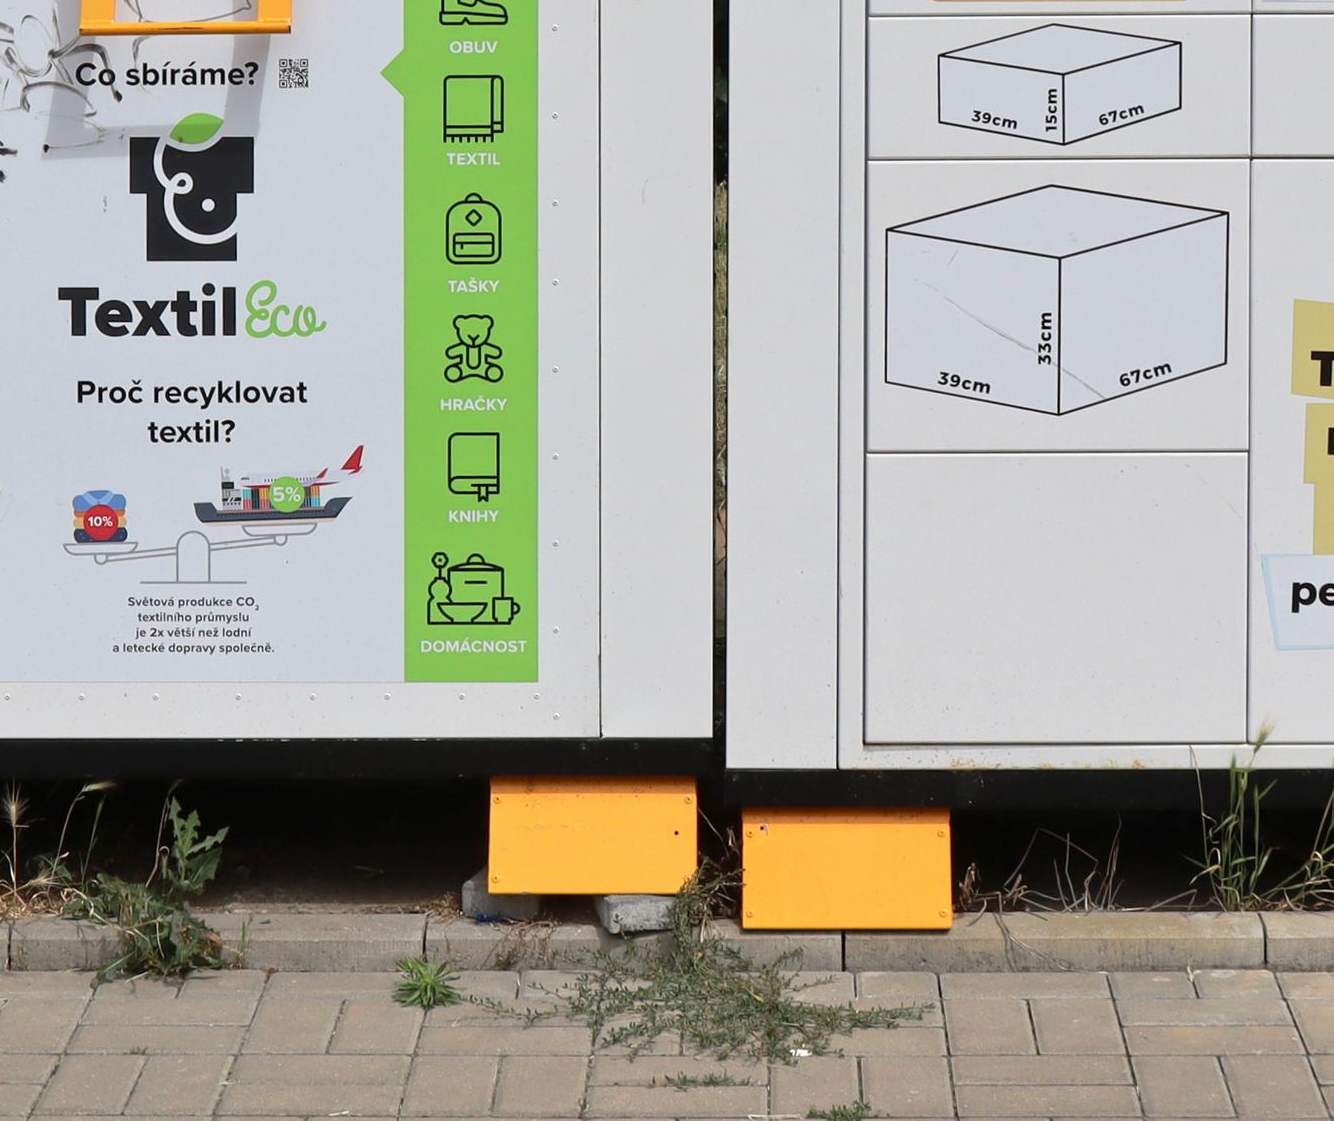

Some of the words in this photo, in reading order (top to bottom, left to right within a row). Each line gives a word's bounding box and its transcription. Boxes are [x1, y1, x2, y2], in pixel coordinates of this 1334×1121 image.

[449, 40, 498, 54] OBUV
[75, 62, 116, 86] Co
[125, 61, 259, 86] sbíráme?
[1046, 87, 1058, 132] 15cm
[1099, 102, 1145, 127] 67cm
[971, 109, 1018, 130] 39cm
[446, 152, 501, 166] TEXTIL
[448, 277, 500, 293] TAŠKY
[1038, 312, 1053, 365] 33cm
[1119, 361, 1173, 388] 67cm
[937, 371, 992, 395] 39cm
[77, 380, 144, 404] Proč
[153, 380, 308, 410] recyklovat
[440, 396, 507, 411] HRAČKY
[148, 419, 236, 443] textil?
[272, 487, 301, 503] 5%
[87, 516, 113, 528] 10%
[448, 509, 499, 523] KNIHY
[127, 596, 175, 607] Světová
[178, 596, 233, 610] produkce
[137, 612, 193, 623] textilního
[195, 611, 250, 625] průmyslu
[135, 627, 148, 640] je
[150, 628, 164, 638] 2x
[167, 627, 196, 638] větší
[198, 627, 219, 638] než
[222, 626, 252, 638] lodní
[123, 642, 165, 653] letecké
[168, 642, 216, 655] dopravy
[218, 641, 275, 656] společně.
[420, 636, 527, 653] DOMÁCNOST
